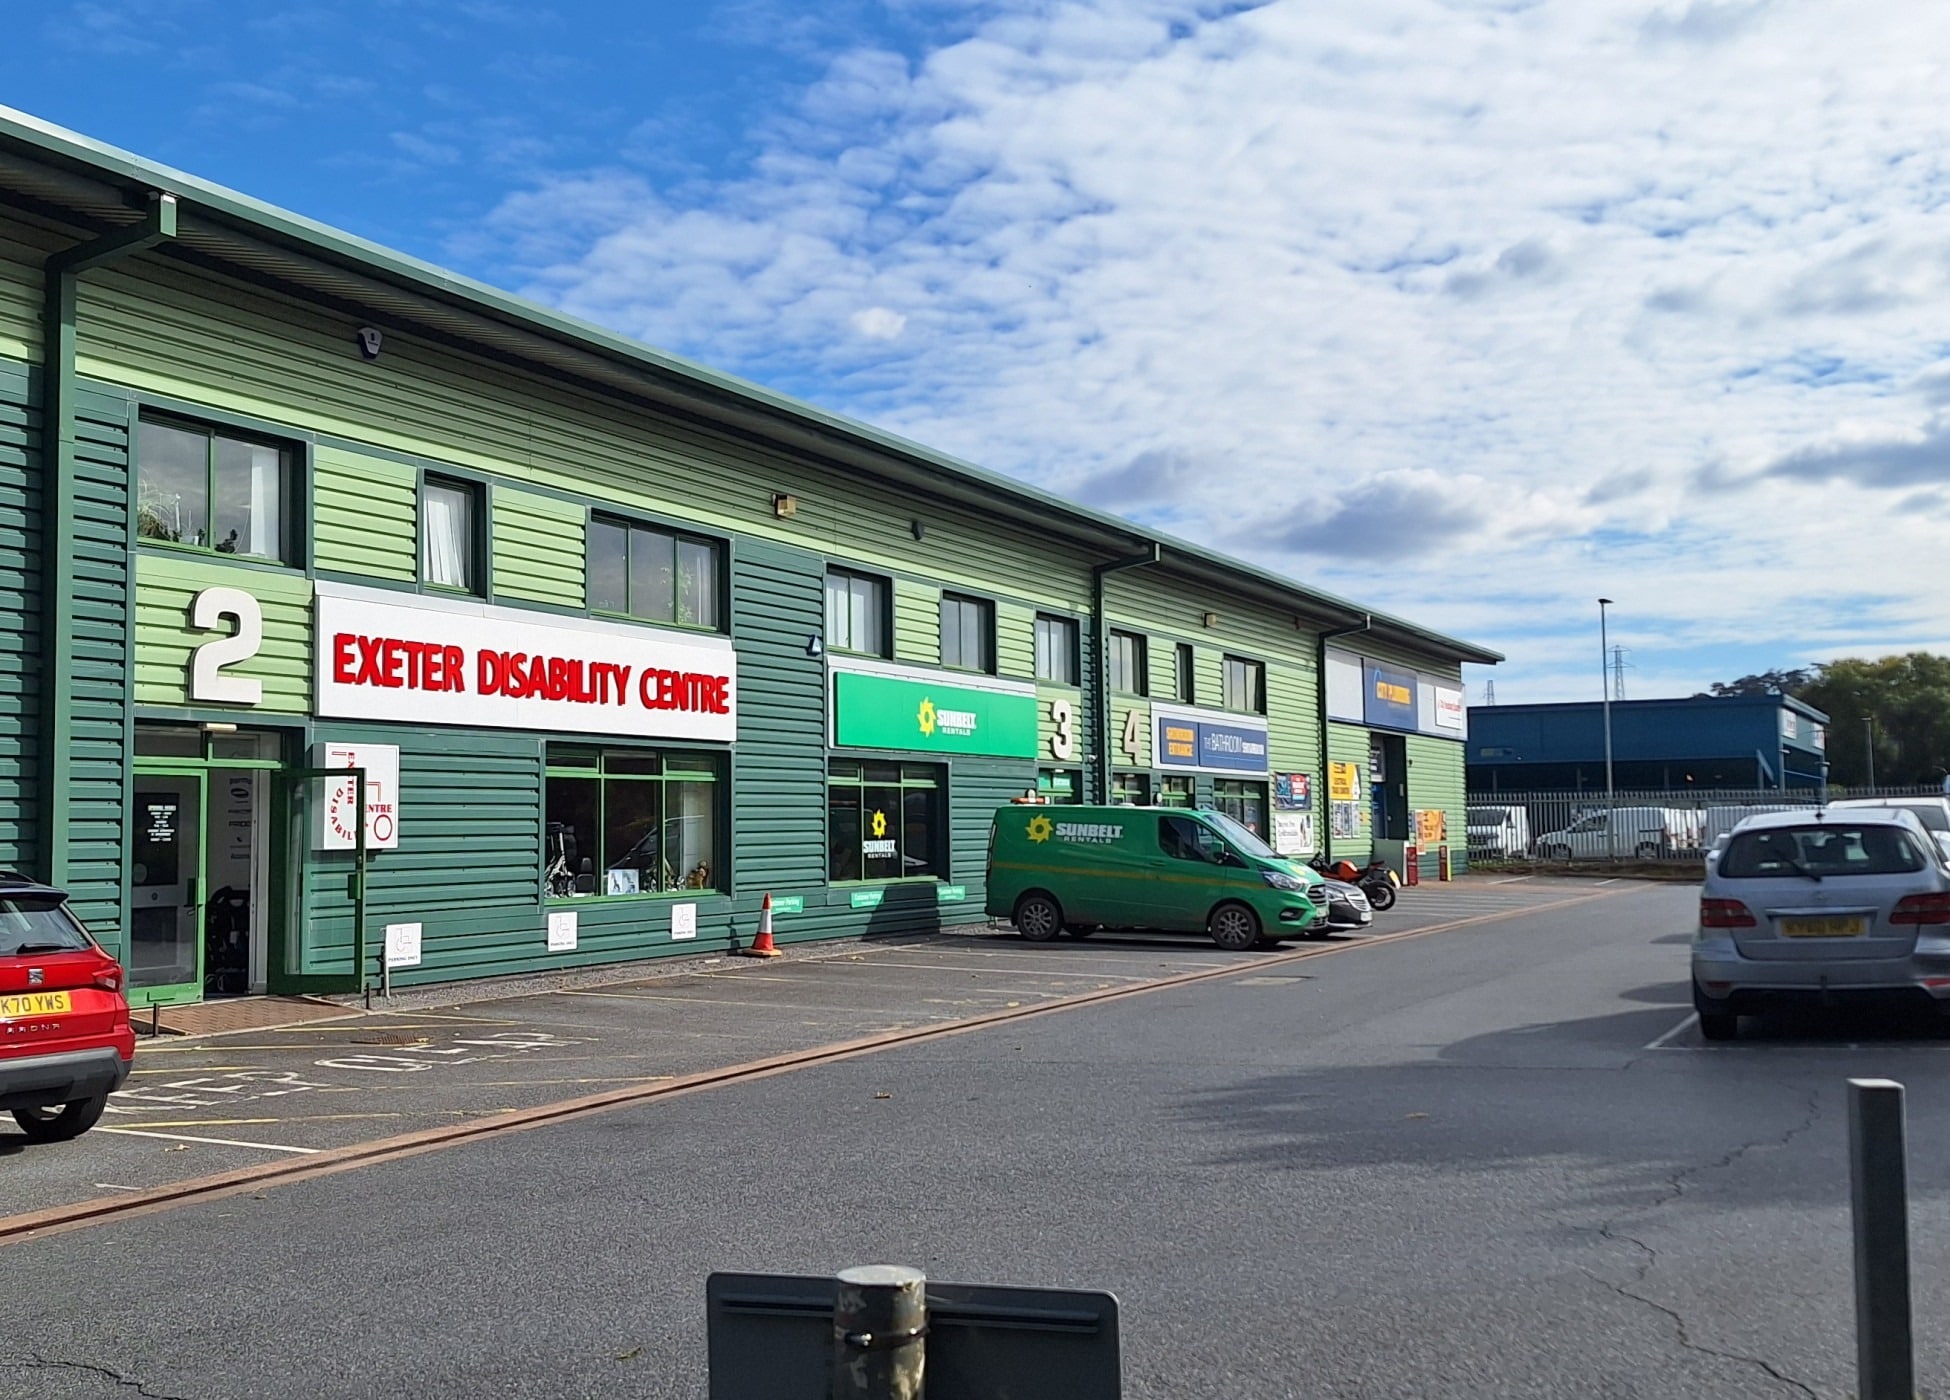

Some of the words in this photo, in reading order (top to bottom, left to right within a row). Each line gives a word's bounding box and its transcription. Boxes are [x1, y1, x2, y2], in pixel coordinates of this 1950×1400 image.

[190, 586, 262, 705] 2
[333, 632, 464, 692] EXETER
[477, 648, 631, 706] DISABILITY
[639, 667, 730, 714] CENTRE
[936, 709, 977, 730] SUNBELT
[1052, 700, 1073, 759] 3
[1124, 709, 1141, 766] 4
[347, 752, 355, 804] EXTER
[863, 840, 896, 854] SUNBELT
[1055, 822, 1124, 839] SUNBELT
[35, 994, 64, 1011] YWS
